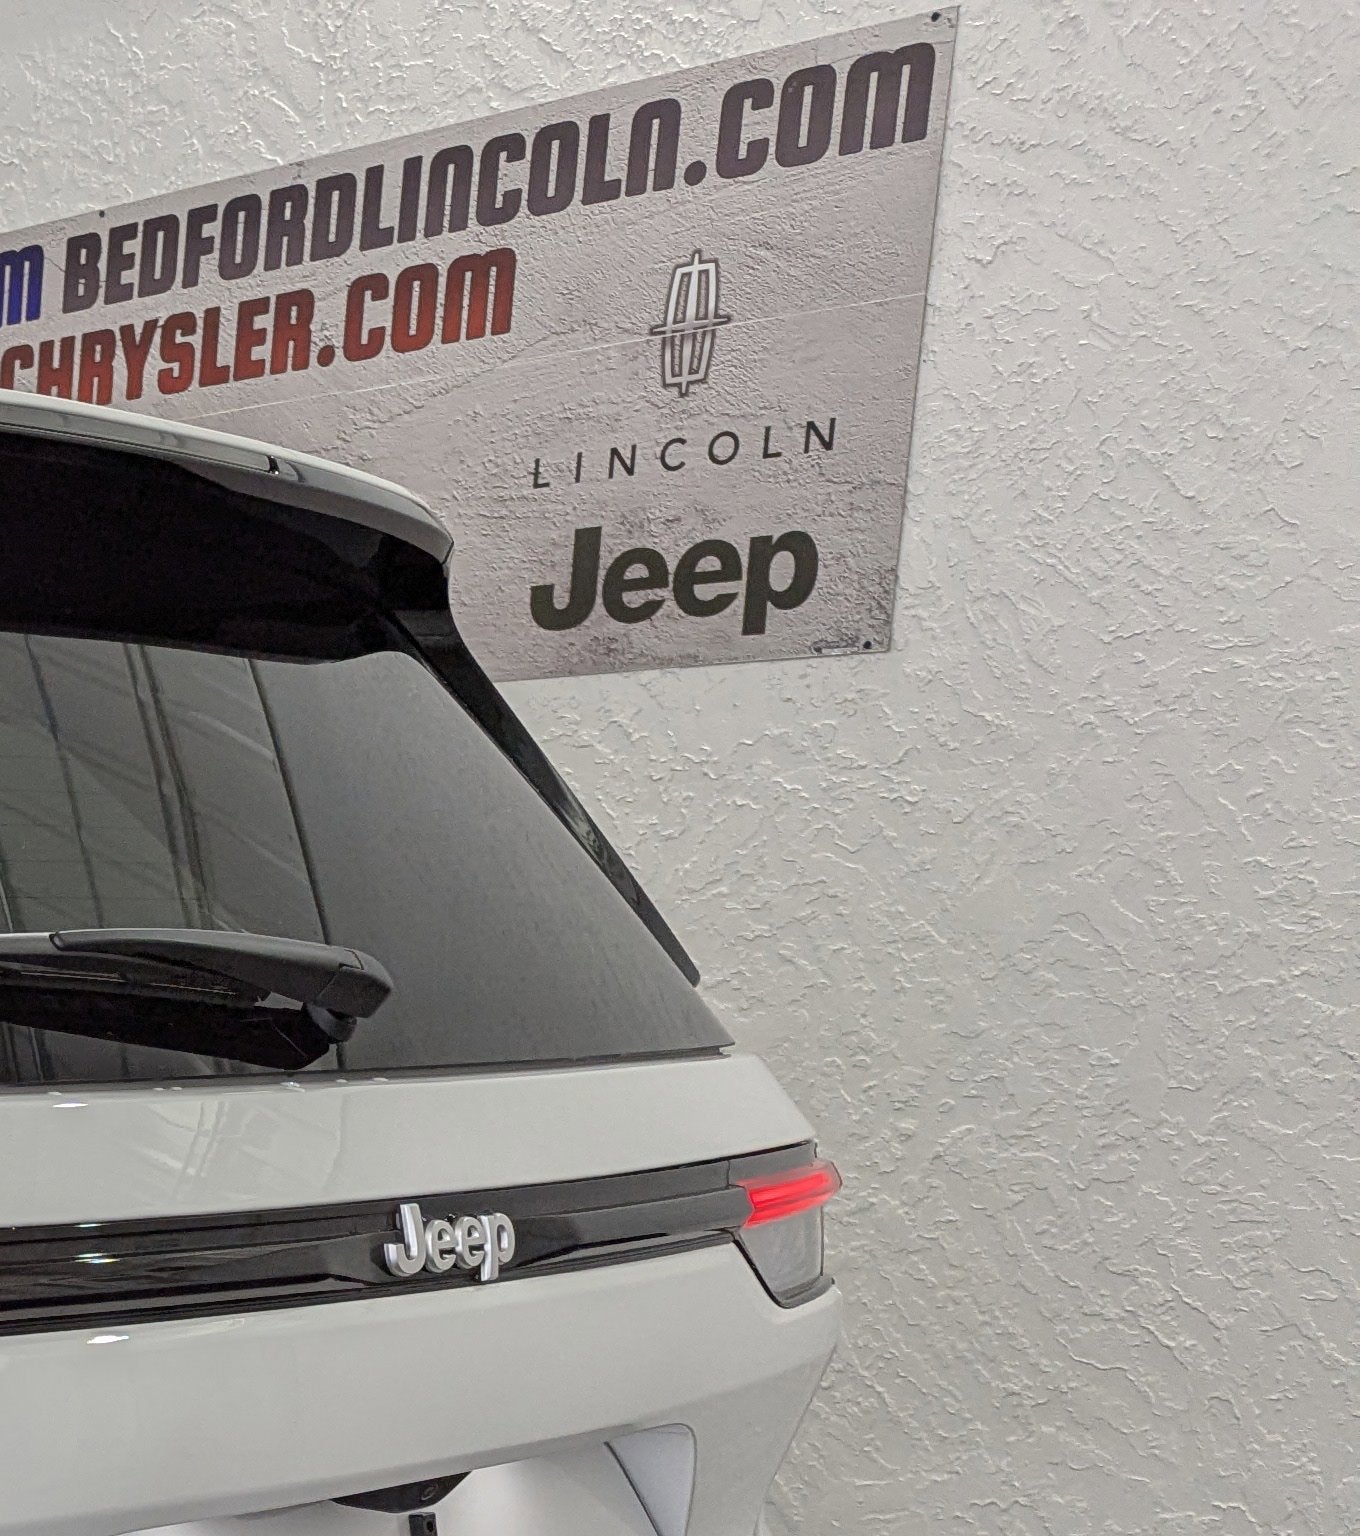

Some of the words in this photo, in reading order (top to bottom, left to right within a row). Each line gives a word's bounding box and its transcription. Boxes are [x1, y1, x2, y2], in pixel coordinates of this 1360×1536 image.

[62, 41, 936, 314] BEDFORDLINCOLN.COM
[531, 417, 837, 489] LINCOLN
[529, 525, 820, 636] Jeep
[383, 1202, 516, 1282] Jeep
